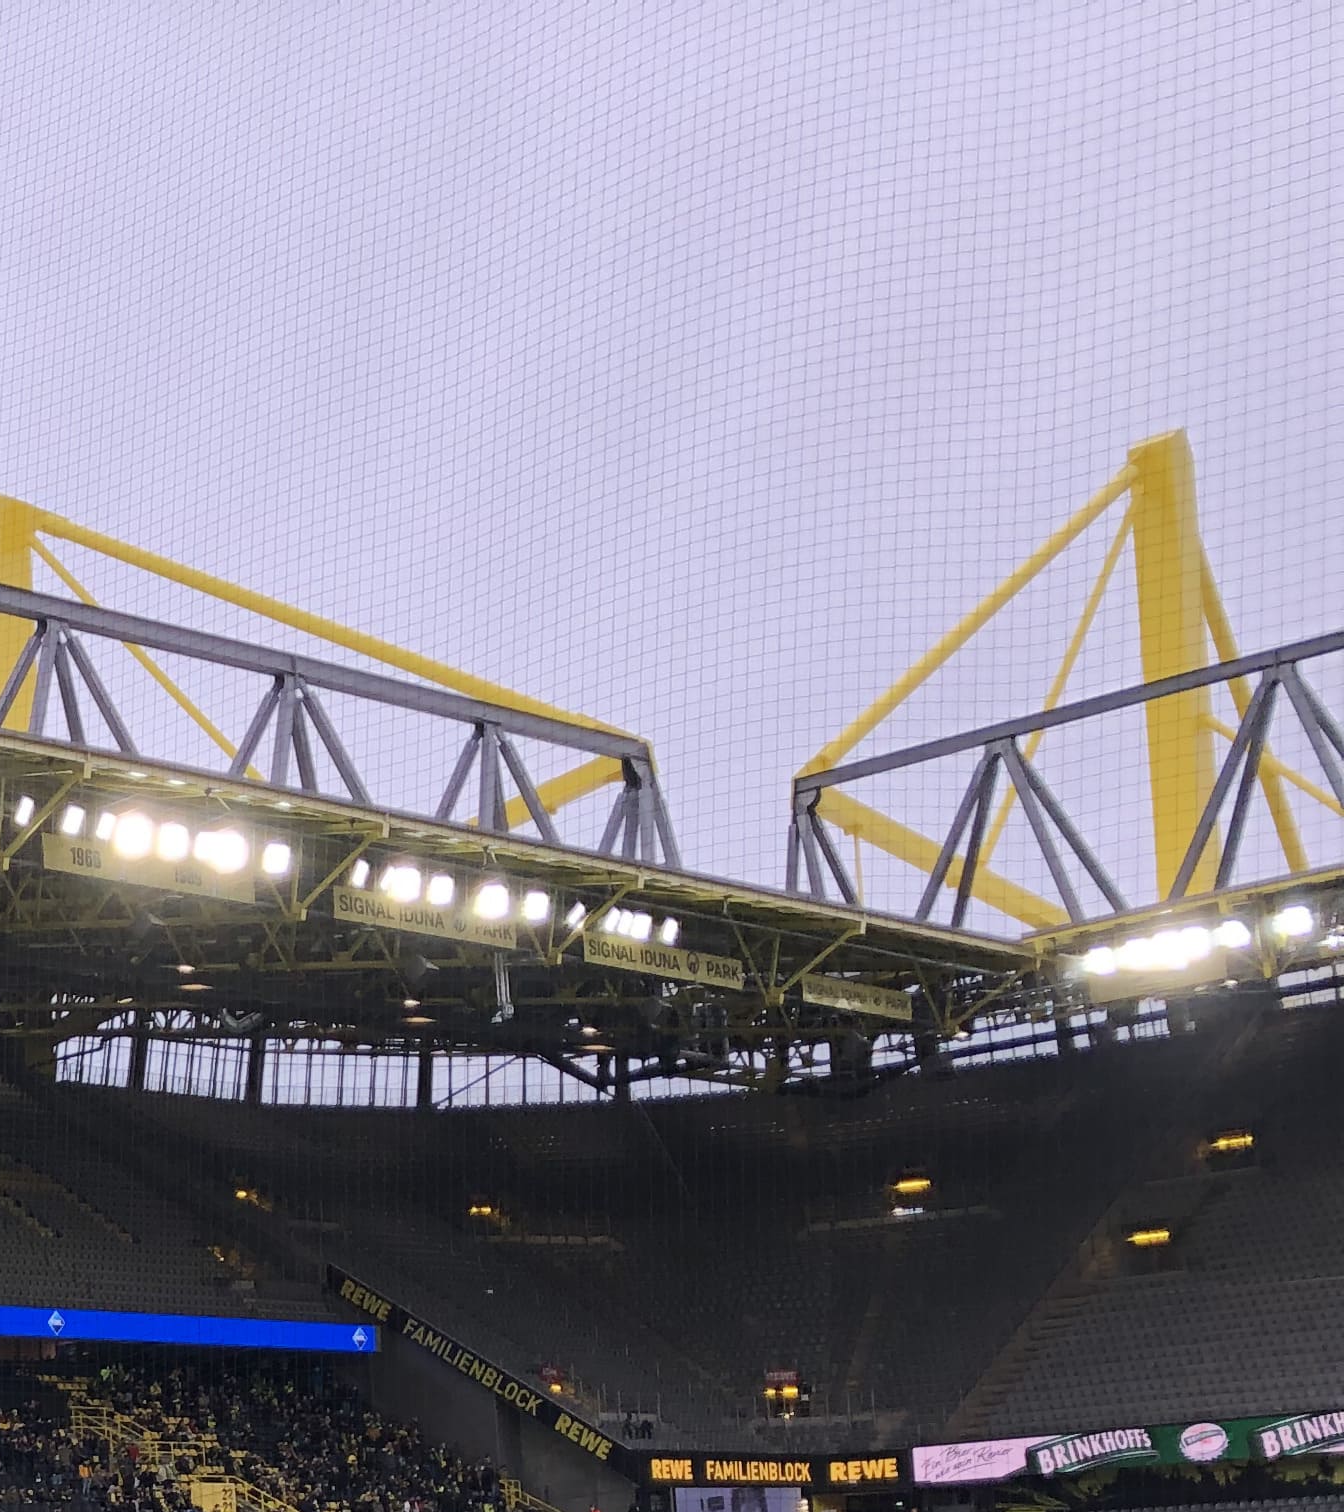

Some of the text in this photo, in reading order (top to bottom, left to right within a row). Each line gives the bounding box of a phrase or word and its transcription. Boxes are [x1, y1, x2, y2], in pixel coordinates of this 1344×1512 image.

[338, 894, 512, 941] SIGNAL IDUNA PARK
[588, 939, 741, 982] SIGNAL IDUNA PARK
[339, 1279, 613, 1461] REWE FAMILIENBLOCK REWE
[650, 1458, 899, 1483] REWE FAMILIENBLOCK REWE
